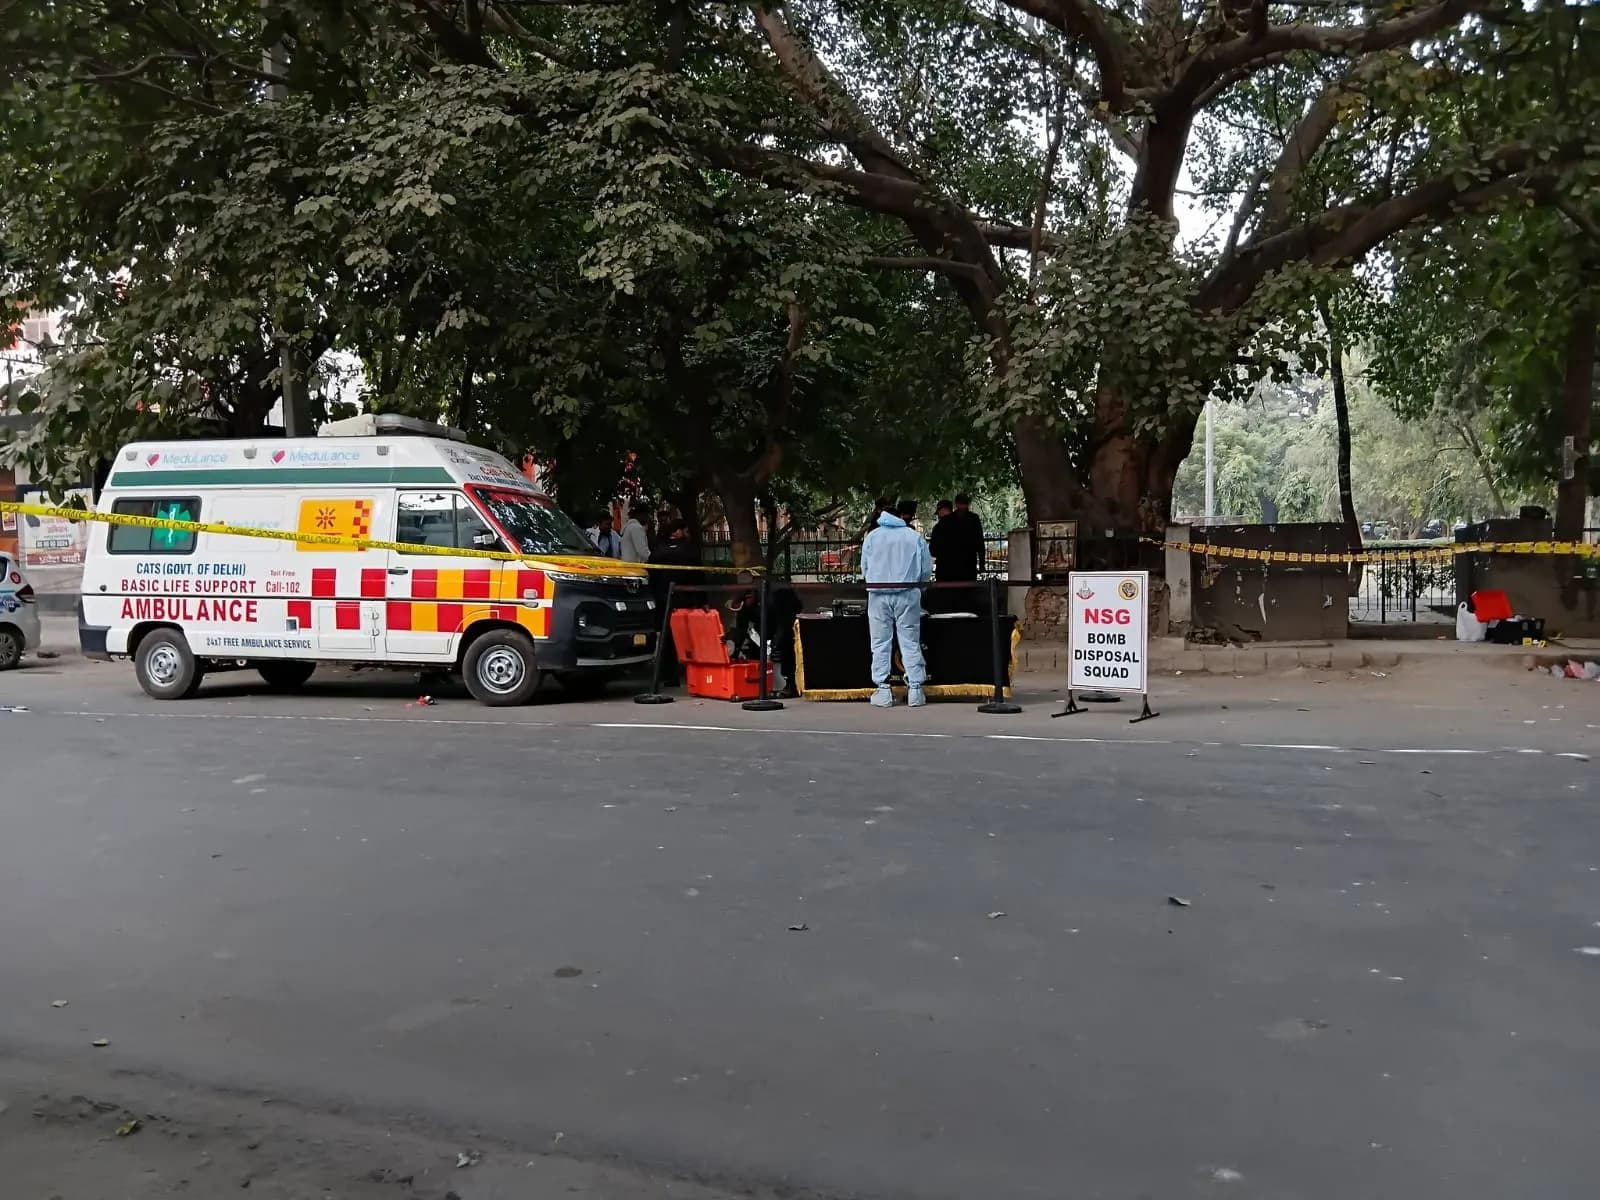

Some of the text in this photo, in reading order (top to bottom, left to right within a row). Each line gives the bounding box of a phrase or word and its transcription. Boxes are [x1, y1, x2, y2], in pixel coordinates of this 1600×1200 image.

[136, 562, 246, 576] CATS (GOVT. OF DELHI)
[121, 579, 257, 593] BASIC LIFE SUPPORT
[265, 581, 301, 594] Call-102
[120, 598, 258, 622] AMBULANCE
[1084, 608, 1131, 625] NSG
[223, 638, 239, 647] FREE
[241, 638, 283, 649] AMBULANCE
[284, 639, 312, 649] SERVICE
[1087, 632, 1126, 645] BOMB
[1074, 649, 1140, 663] DISPOSAL
[1083, 666, 1129, 679] SQUAD
